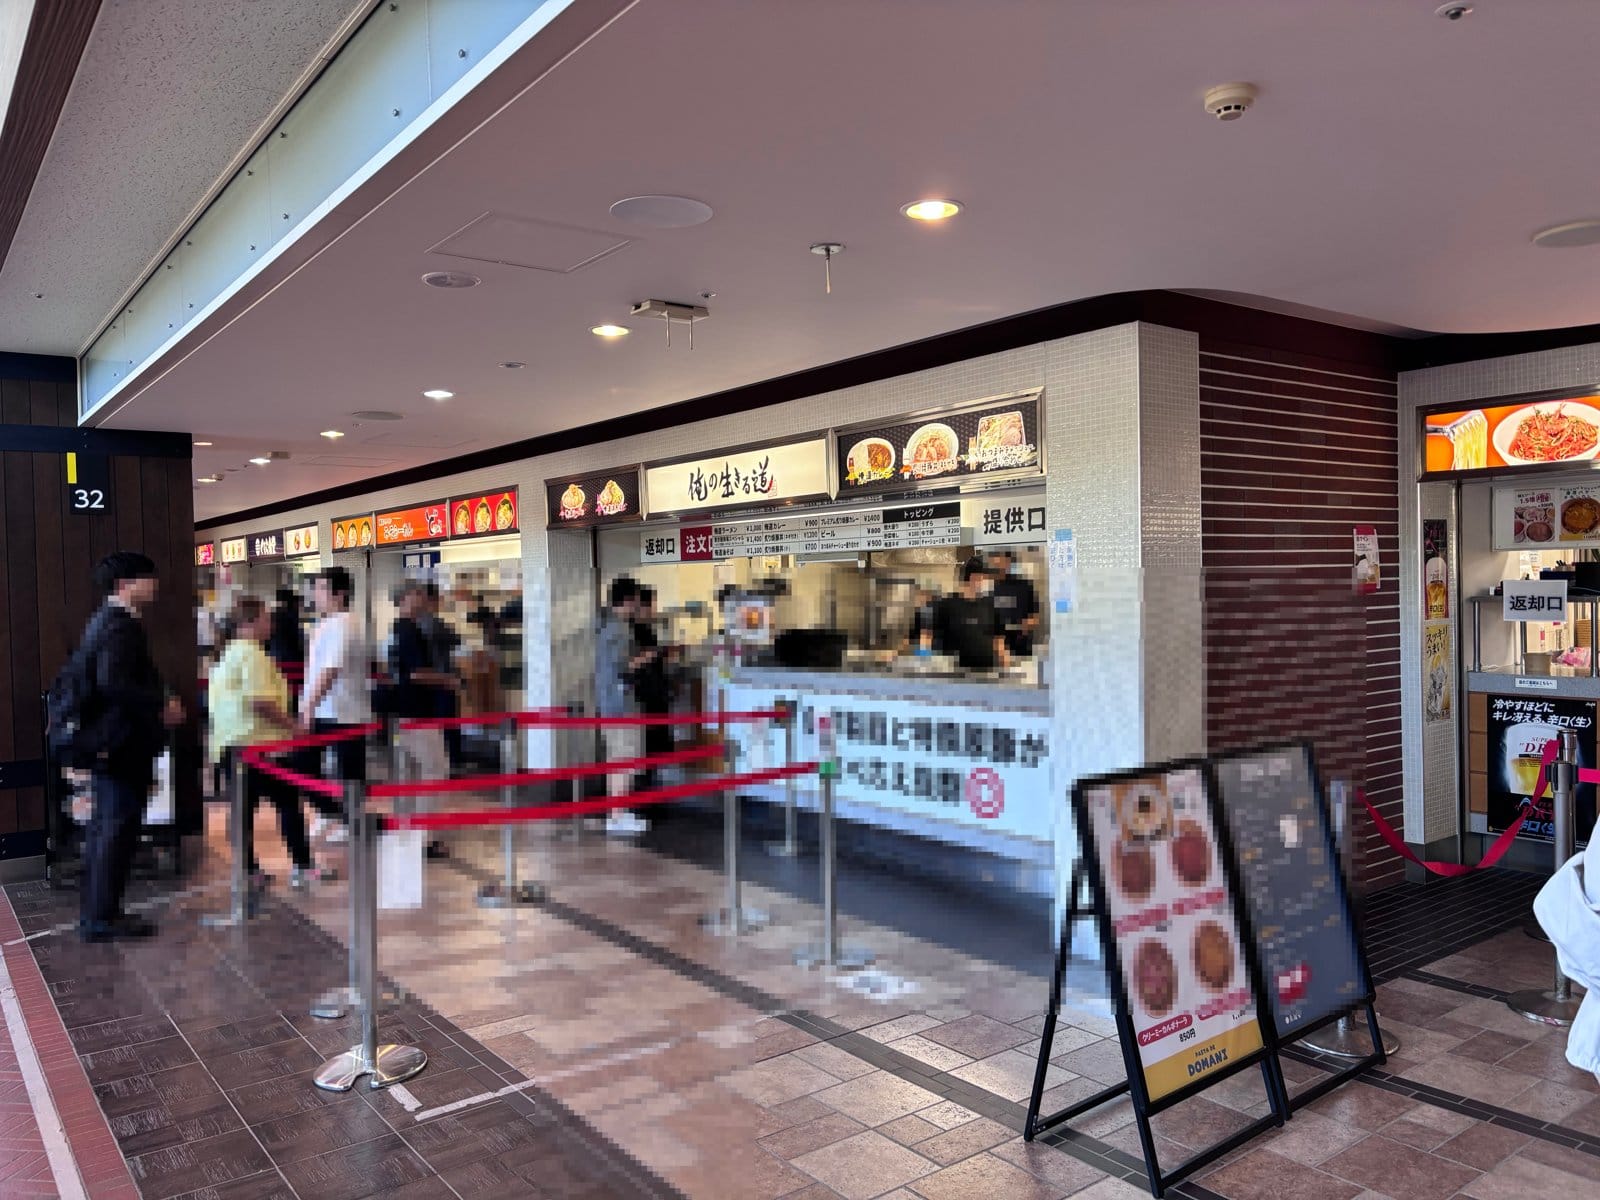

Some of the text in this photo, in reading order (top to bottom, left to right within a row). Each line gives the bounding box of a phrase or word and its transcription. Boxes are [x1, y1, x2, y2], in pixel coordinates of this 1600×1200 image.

[688, 456, 773, 501] 俺の生きる道
[74, 489, 105, 509] 32
[904, 507, 934, 519] トッピング
[983, 507, 1046, 534] 提供口
[685, 534, 713, 553] 注文
[821, 530, 835, 538] ビール
[645, 537, 675, 556] 返却口
[1509, 595, 1563, 611] 返却口
[1492, 699, 1555, 713] 冷やすほどに
[1142, 1016, 1188, 1042] クリーミーカルボナーラ
[1179, 1028, 1196, 1042] 850円
[1187, 1048, 1229, 1077] DOMANI
